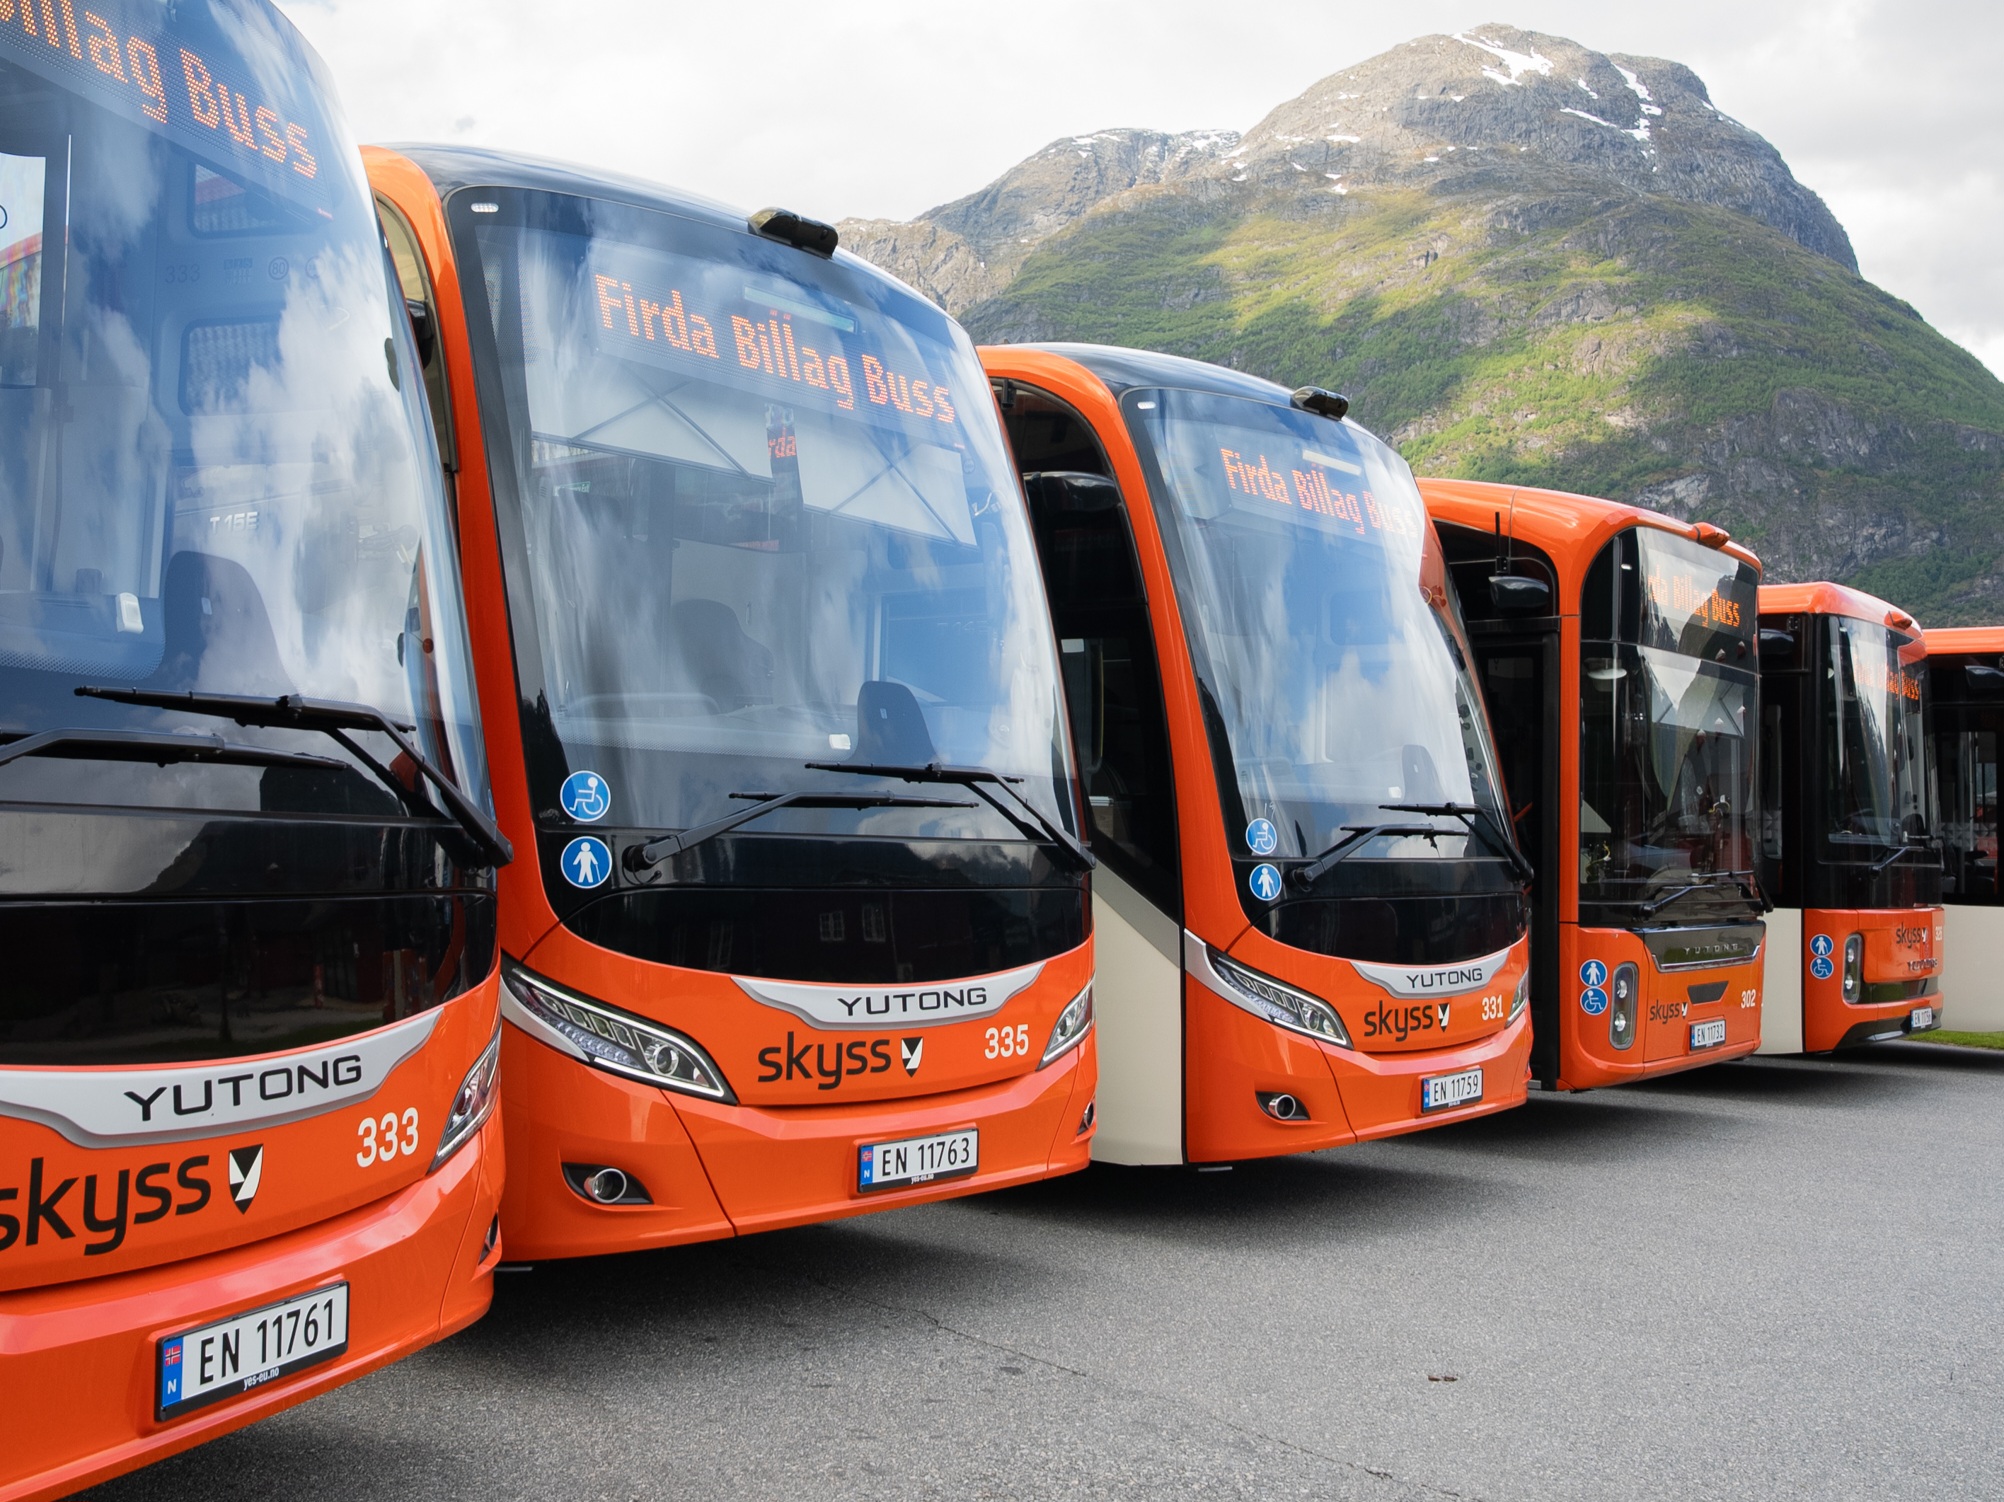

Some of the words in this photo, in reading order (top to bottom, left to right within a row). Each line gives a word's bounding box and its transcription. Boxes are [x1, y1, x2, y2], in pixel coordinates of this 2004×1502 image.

[0, 0, 168, 124] illag
[179, 47, 317, 179] Buss
[271, 261, 285, 275] 80
[595, 274, 720, 359] Firda
[731, 315, 855, 410] Billag
[862, 353, 956, 423] Buss
[1221, 448, 1292, 505] Firda
[1292, 468, 1365, 535] Billag
[210, 516, 220, 533] T
[1711, 587, 1740, 628] Buss
[1684, 943, 1739, 955] YUTONG
[1895, 921, 1921, 949] skyss
[1406, 967, 1483, 989] YUTONG
[836, 986, 988, 1017] YUTONG
[1481, 994, 1504, 1020] 331
[1649, 999, 1680, 1024] skyss
[1740, 989, 1756, 1008] 302
[1364, 1000, 1434, 1042] skyss
[1697, 1027, 1705, 1044] EN
[1707, 1023, 1723, 1041] 11732
[984, 1023, 1030, 1060] 335
[757, 1031, 892, 1090] skyss
[123, 1054, 362, 1122] YUTONG
[1433, 1080, 1446, 1103] EN
[1451, 1074, 1479, 1098] 11759
[355, 1106, 420, 1168] 333
[882, 1146, 908, 1177] EN
[917, 1137, 970, 1171] 11763
[863, 1169, 871, 1179] N
[0, 1155, 212, 1256] skyss
[199, 1327, 241, 1386] EN
[256, 1298, 334, 1364] 11761
[167, 1378, 177, 1395] N
[243, 1367, 280, 1391] yes-eu.no
